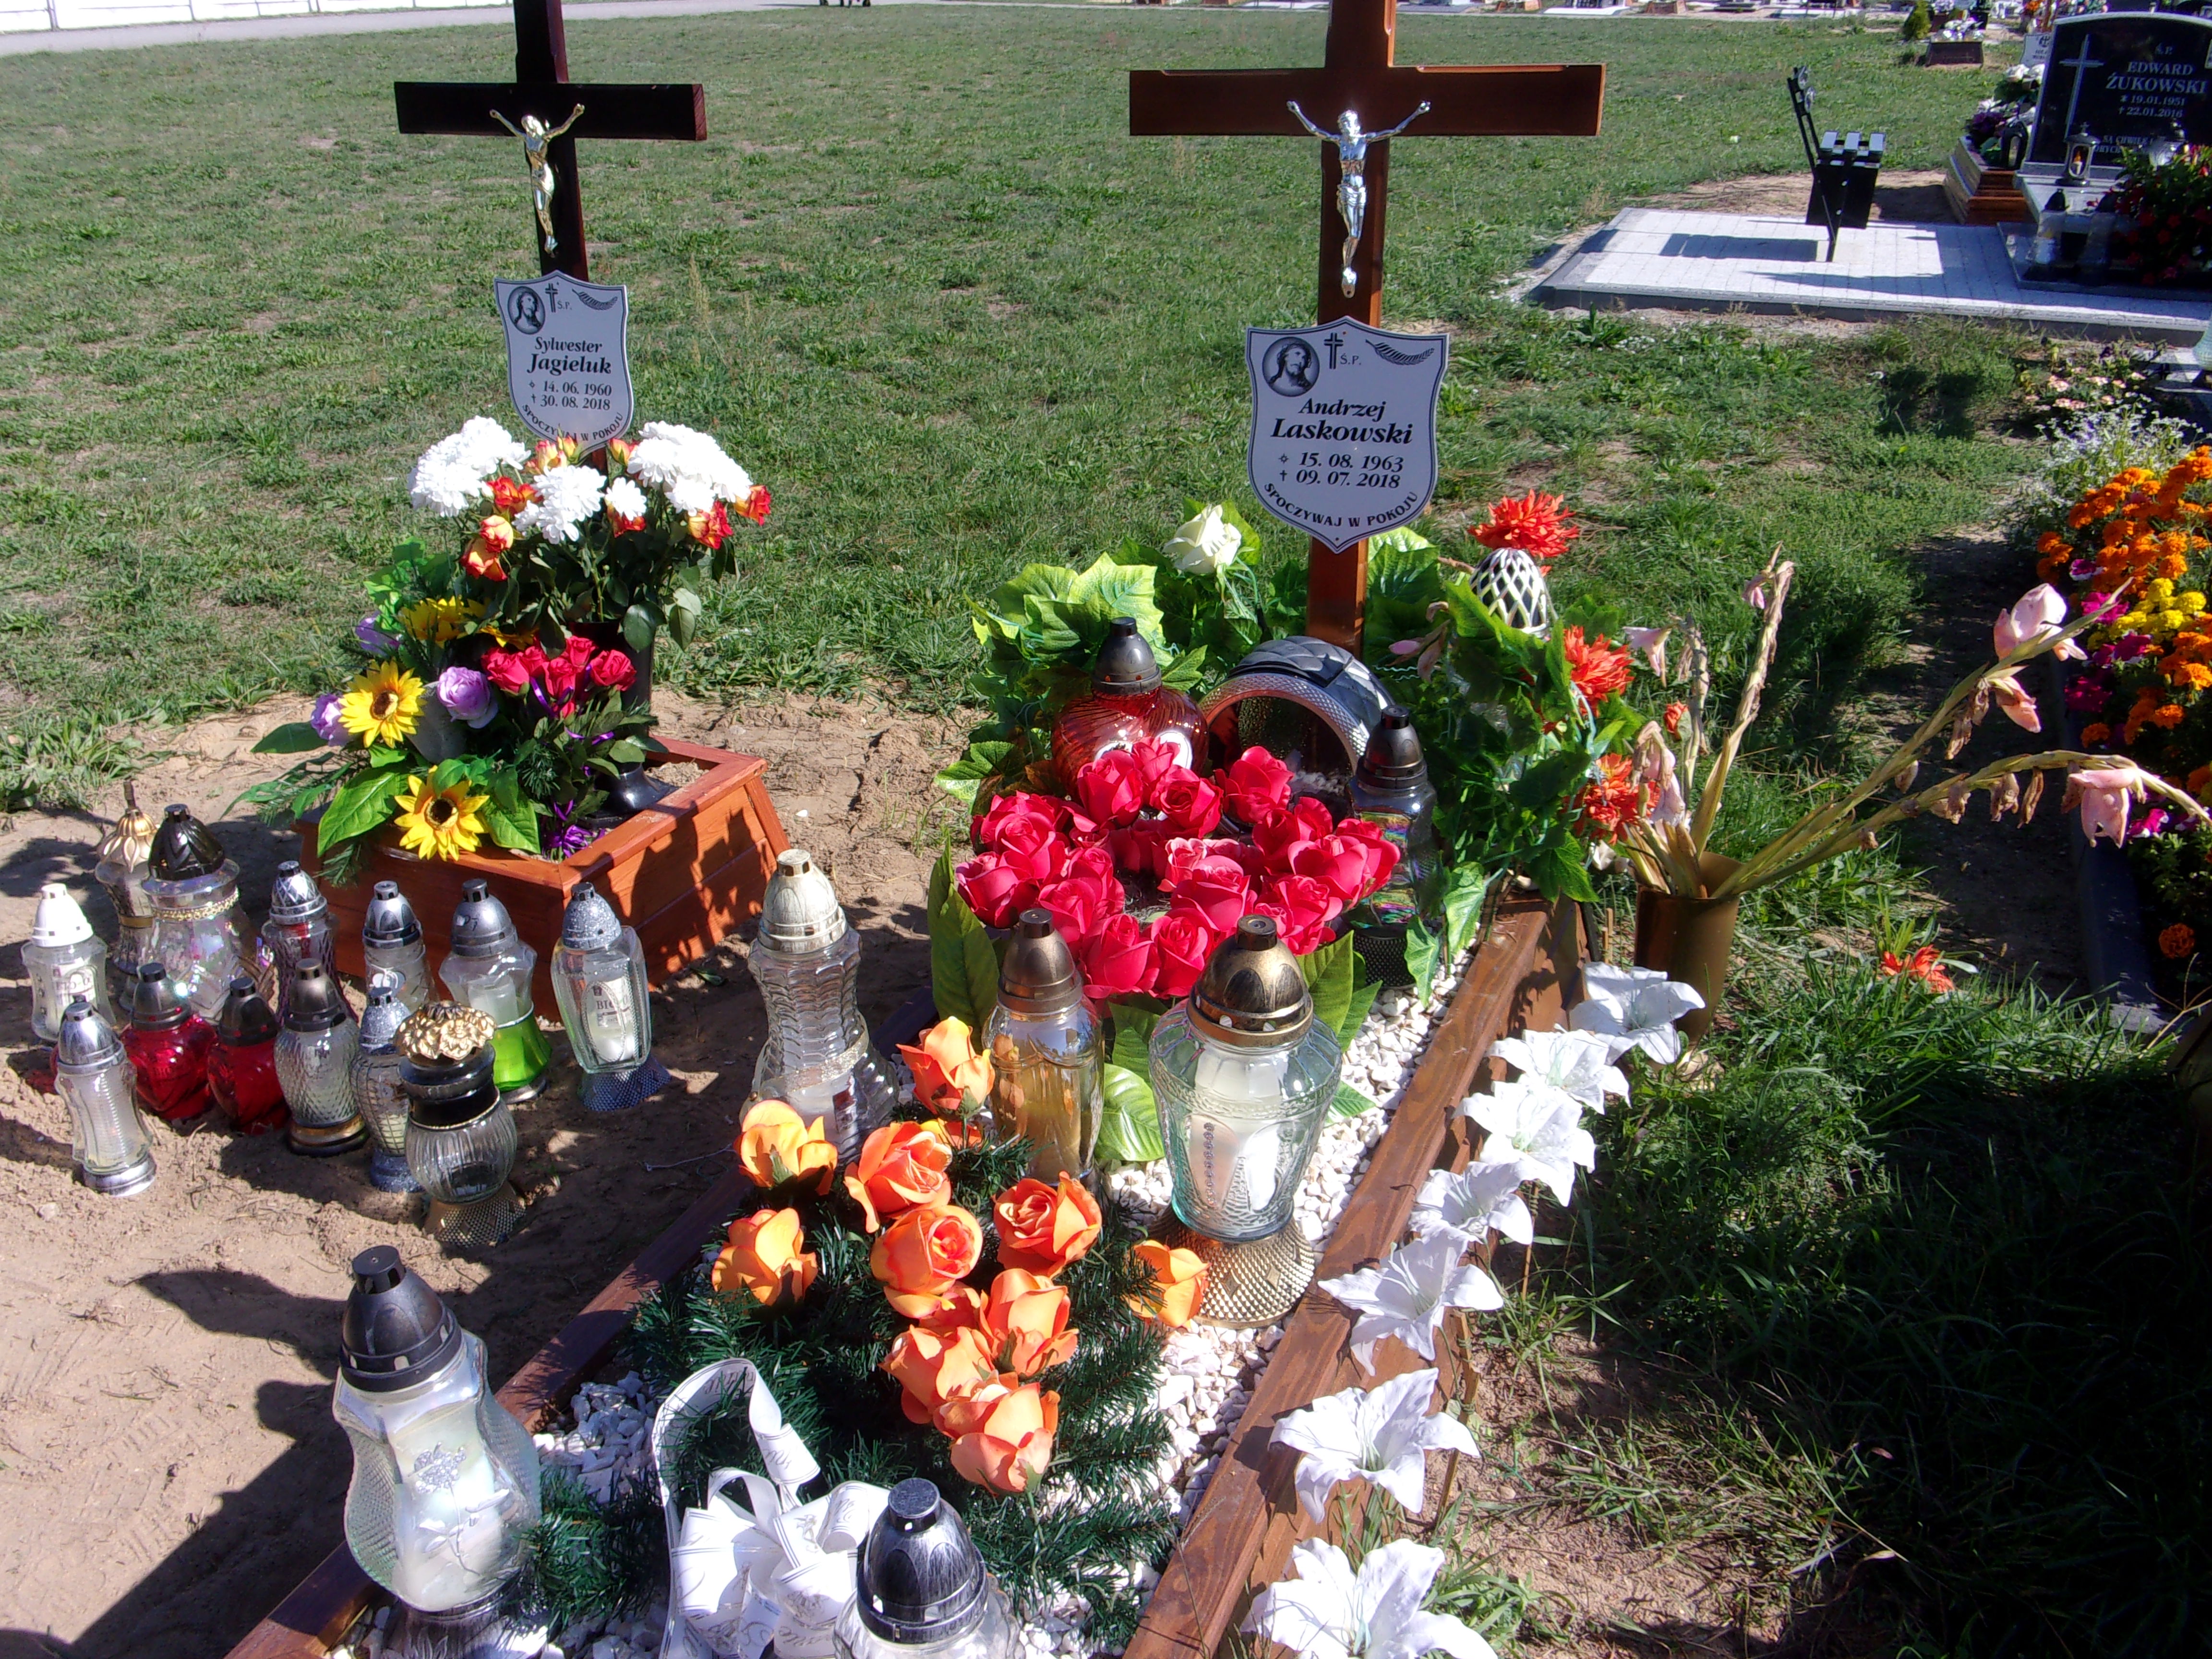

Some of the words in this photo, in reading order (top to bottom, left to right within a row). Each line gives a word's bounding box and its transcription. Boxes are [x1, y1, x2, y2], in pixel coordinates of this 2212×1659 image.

[2128, 61, 2193, 75] EDWARD
[2131, 96, 2185, 106] 19.01.1951
[535, 337, 602, 354] Sylwester
[527, 353, 612, 376] Jagieluk
[543, 381, 558, 393] 14.
[563, 382, 579, 394] 06.
[585, 384, 612, 396] 1960
[541, 395, 558, 407] 30.
[562, 396, 578, 408] 08.
[582, 397, 610, 410] 2018
[1298, 398, 1386, 422] Andrzej
[593, 412, 623, 440] POKOJU
[1270, 418, 1413, 444] Laskowski
[1299, 451, 1322, 467] 15.
[1329, 454, 1353, 469] 08.
[1362, 455, 1404, 472] 1963
[1296, 469, 1321, 484] 09.
[1328, 472, 1350, 486] 07.
[1357, 473, 1400, 489] 2018
[1264, 482, 1342, 527] SPOCZYWAJ
[1348, 517, 1360, 527] W
[1367, 491, 1418, 526] POKOJU
